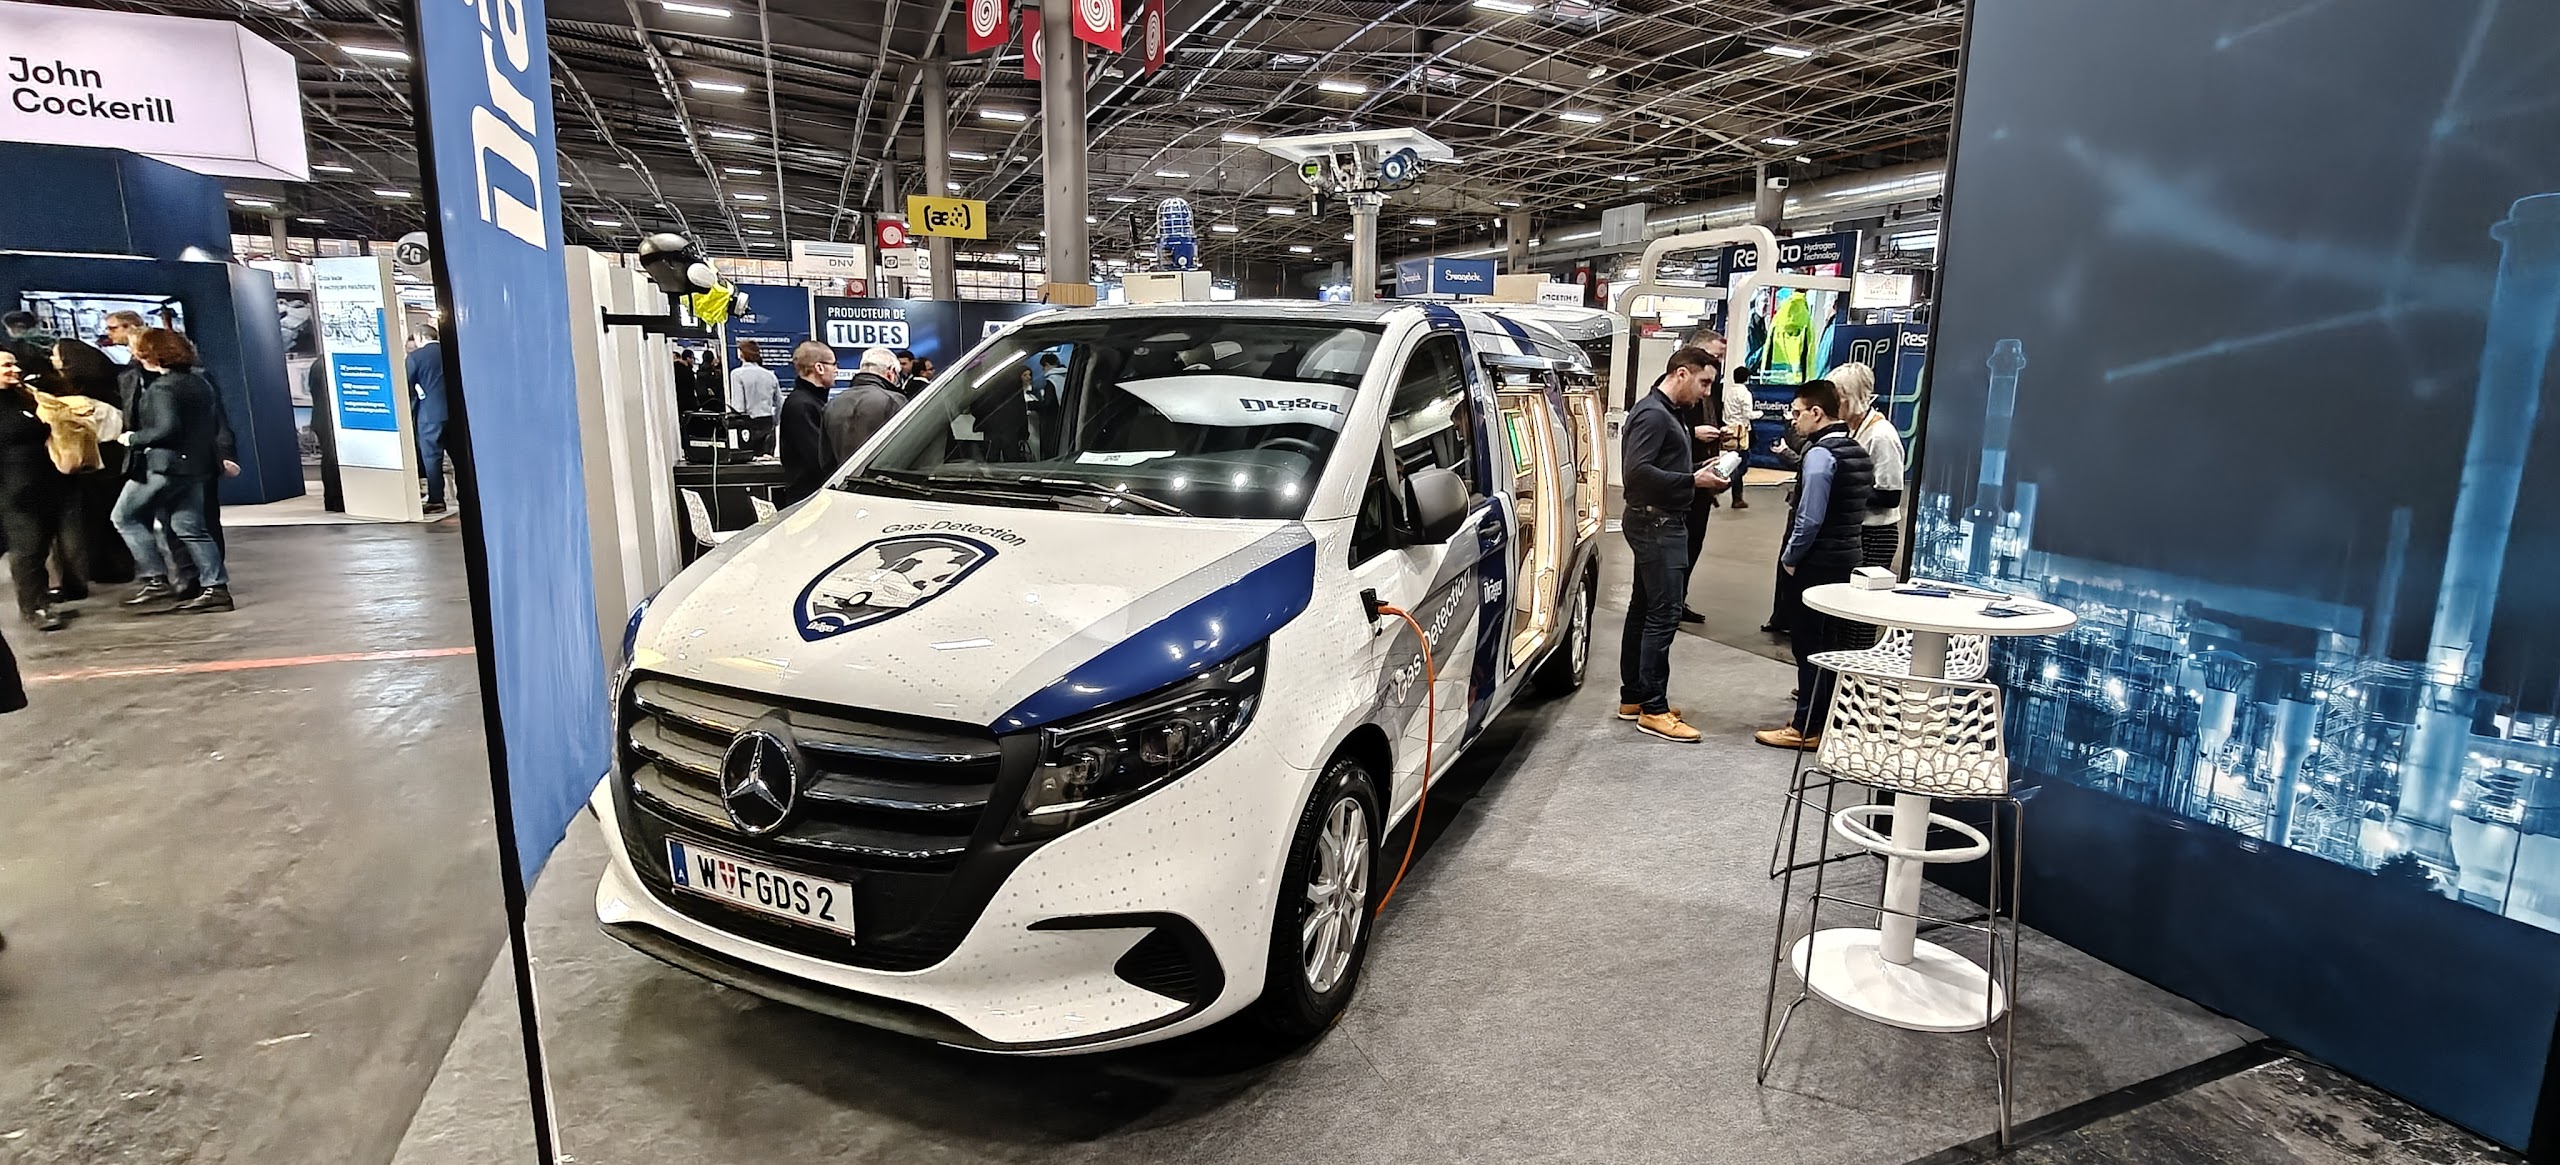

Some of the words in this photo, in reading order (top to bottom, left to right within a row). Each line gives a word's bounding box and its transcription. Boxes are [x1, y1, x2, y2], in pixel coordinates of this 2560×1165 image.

[9, 56, 102, 88] John
[13, 88, 175, 123] Cockerill
[401, 244, 420, 263] 2G
[1733, 244, 1801, 268] Reto
[1803, 251, 1841, 261] Technology
[1804, 242, 1836, 252] Hydrogen
[829, 259, 854, 267] DNV
[828, 306, 890, 320] PRODUCTEUR
[893, 308, 906, 320] DE
[833, 324, 903, 345] TUBES
[1754, 400, 1790, 411] Refueling
[882, 521, 928, 534] Gas
[930, 520, 1027, 547] Detection
[1422, 567, 1471, 663] Detection
[678, 868, 685, 878] A
[697, 854, 716, 889] W
[736, 866, 810, 915] FGDS
